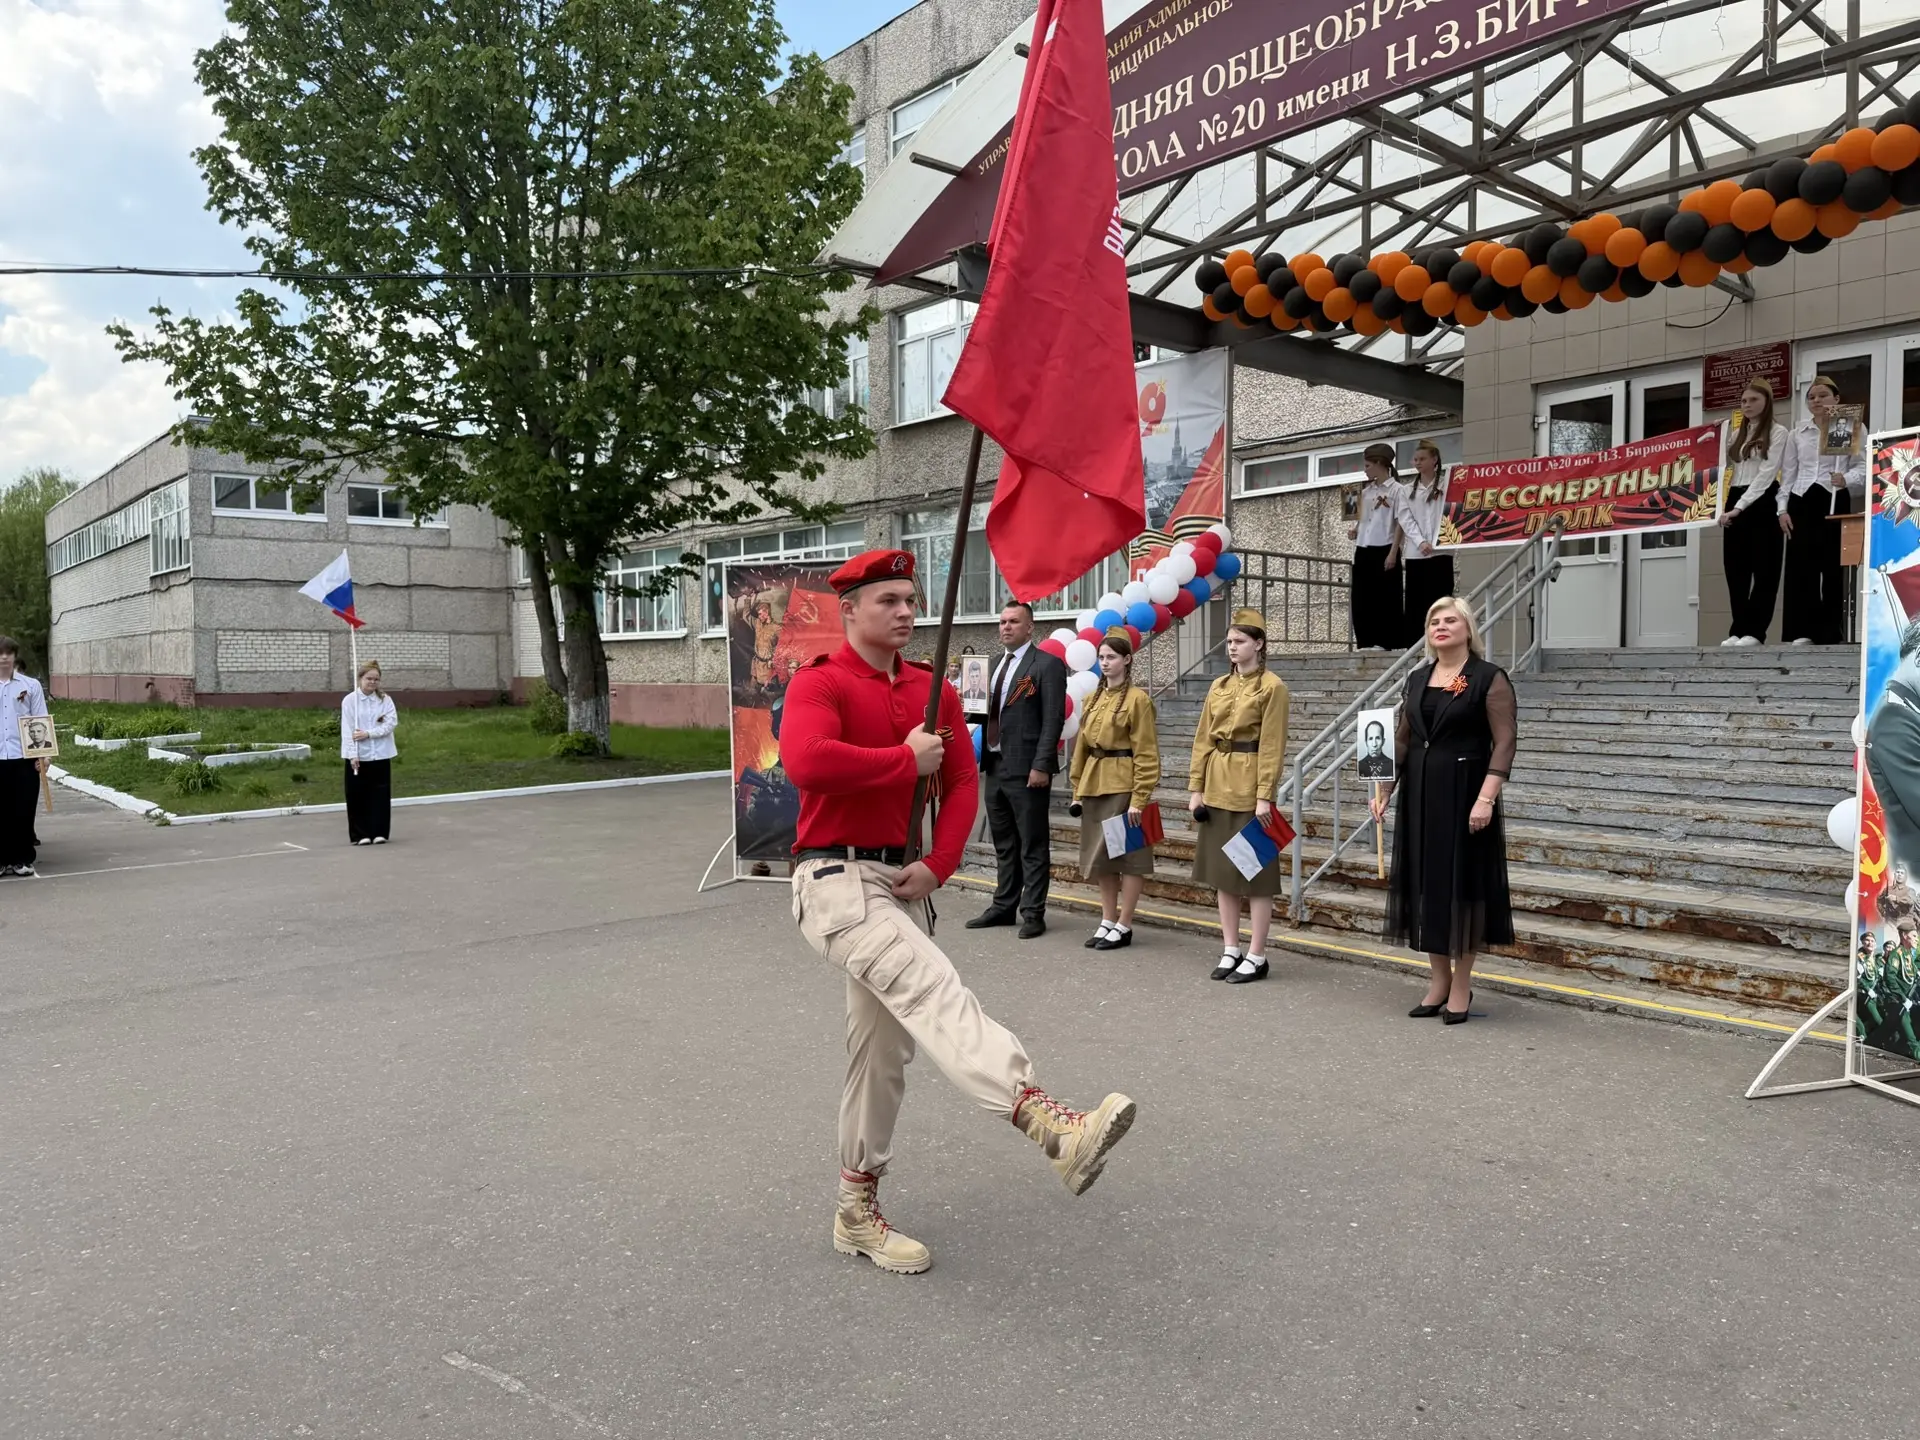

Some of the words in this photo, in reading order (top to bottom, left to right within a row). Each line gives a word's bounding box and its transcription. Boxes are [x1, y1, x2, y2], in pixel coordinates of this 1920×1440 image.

[1108, 0, 1233, 85] НИЦИПАЛЬНОЕ
[1112, 74, 1194, 143] ДНЯЯ
[1202, 0, 1445, 97] ОБЩЕОБРА
[978, 136, 1011, 175] УПРАВ
[1106, 24, 1143, 62] АНИЯ
[1146, 0, 1192, 32] АДМИ
[1114, 131, 1186, 182] ОЛА
[1196, 97, 1266, 151] №20
[1277, 68, 1371, 121] имени
[1710, 364, 1754, 379] ШКОЛА
[1770, 358, 1784, 368] 20
[1463, 454, 1695, 512] БЕССМЕРТНЫЙ
[1473, 465, 1502, 479] МОУ
[1507, 461, 1542, 476] СОШ
[1547, 457, 1571, 472] №20
[1574, 455, 1594, 467] им.
[1597, 449, 1622, 463] Н.З.
[1625, 438, 1691, 459] Бирюкова
[1524, 502, 1616, 534] ПОЛК
